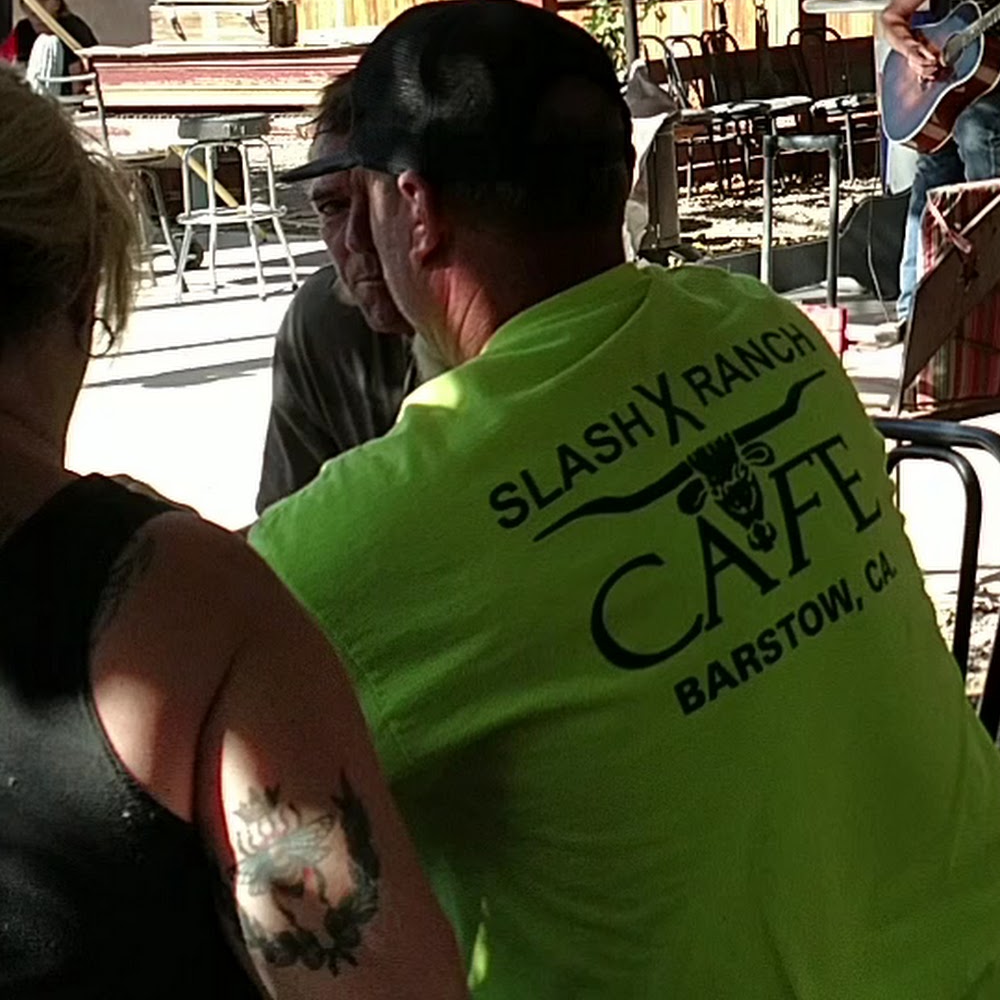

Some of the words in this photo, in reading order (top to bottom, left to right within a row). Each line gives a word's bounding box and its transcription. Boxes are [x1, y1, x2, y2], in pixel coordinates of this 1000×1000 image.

[489, 401, 655, 529] SLASH
[632, 371, 706, 446] X
[681, 322, 816, 406] RANCH
[591, 434, 882, 670] CAFE
[674, 578, 863, 716] BARSTOW,
